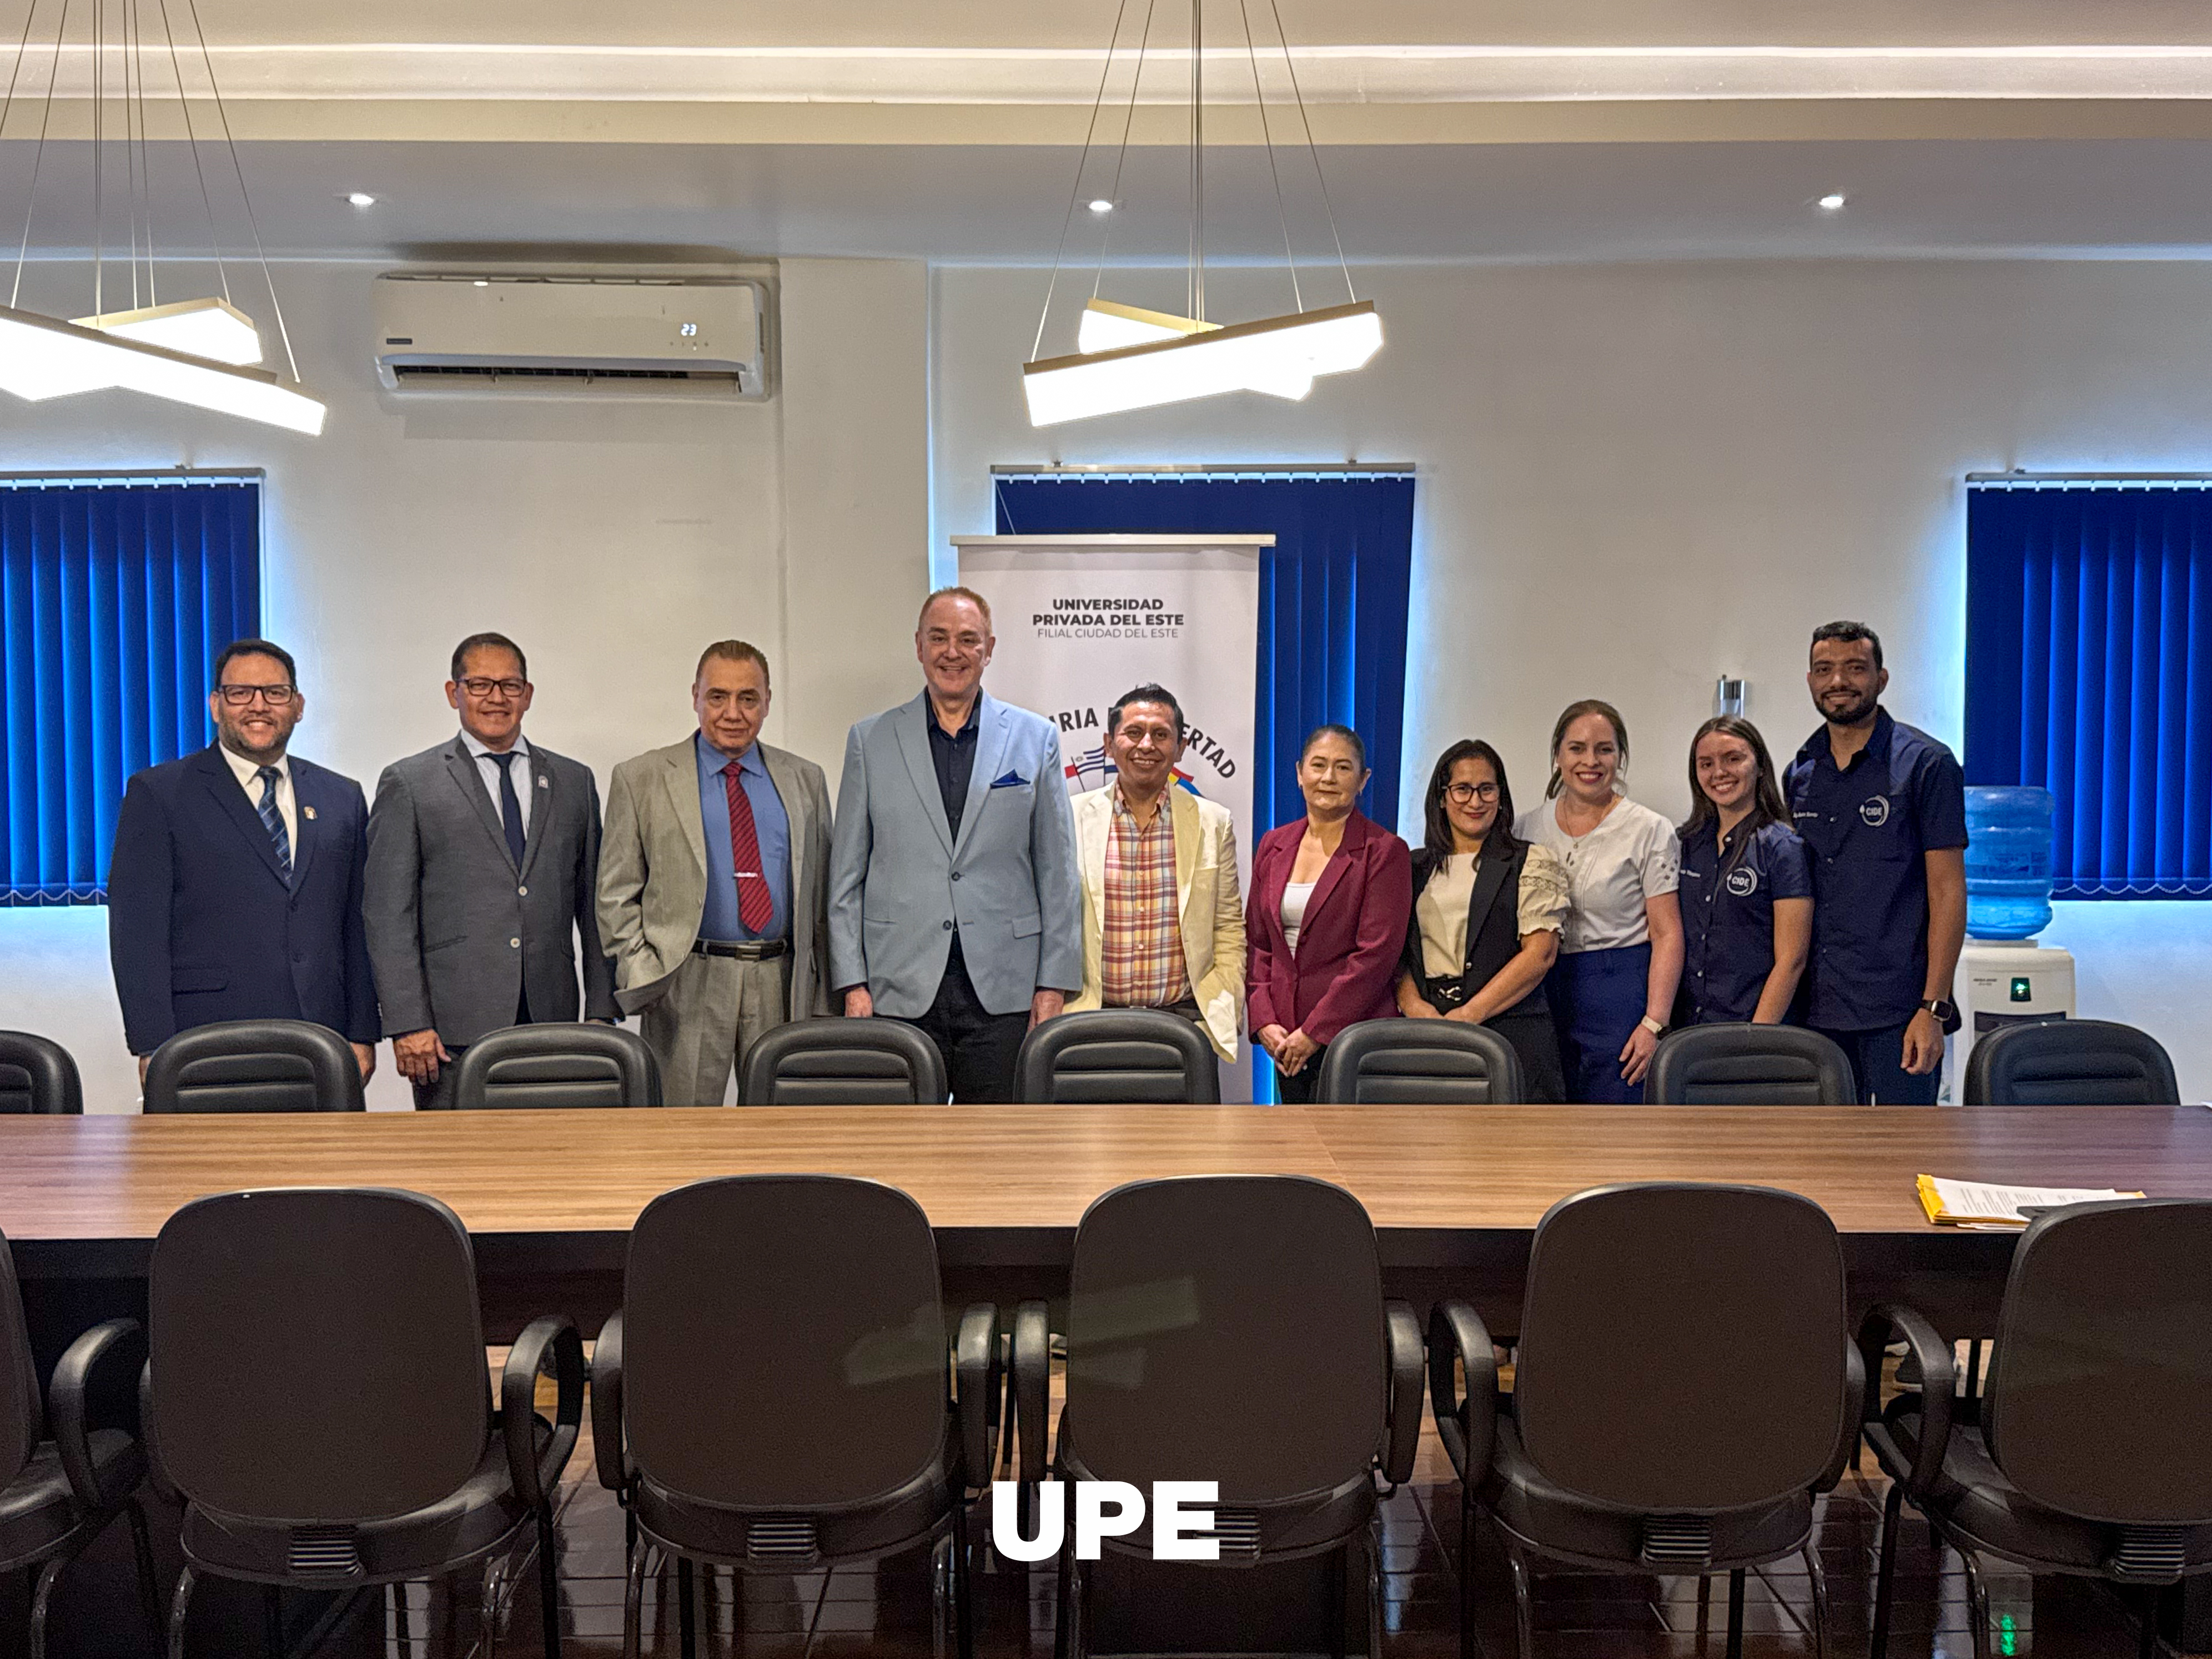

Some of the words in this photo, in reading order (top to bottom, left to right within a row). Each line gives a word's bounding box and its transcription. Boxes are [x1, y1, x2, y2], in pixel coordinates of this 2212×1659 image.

[681, 324, 697, 336] 23
[1053, 599, 1164, 610] UNIVERSIDAD
[1033, 615, 1105, 625] PRIVADA
[1110, 615, 1141, 625] DEL
[1145, 615, 1184, 625] ESTE
[1038, 629, 1072, 638] FILIAL
[1075, 629, 1122, 638] CIUDAD
[1125, 629, 1148, 638] DEL
[1151, 629, 1178, 638] ESTE
[1049, 707, 1099, 732] RIA
[1866, 807, 1882, 816] CIDE
[1732, 876, 1750, 887] CIDE
